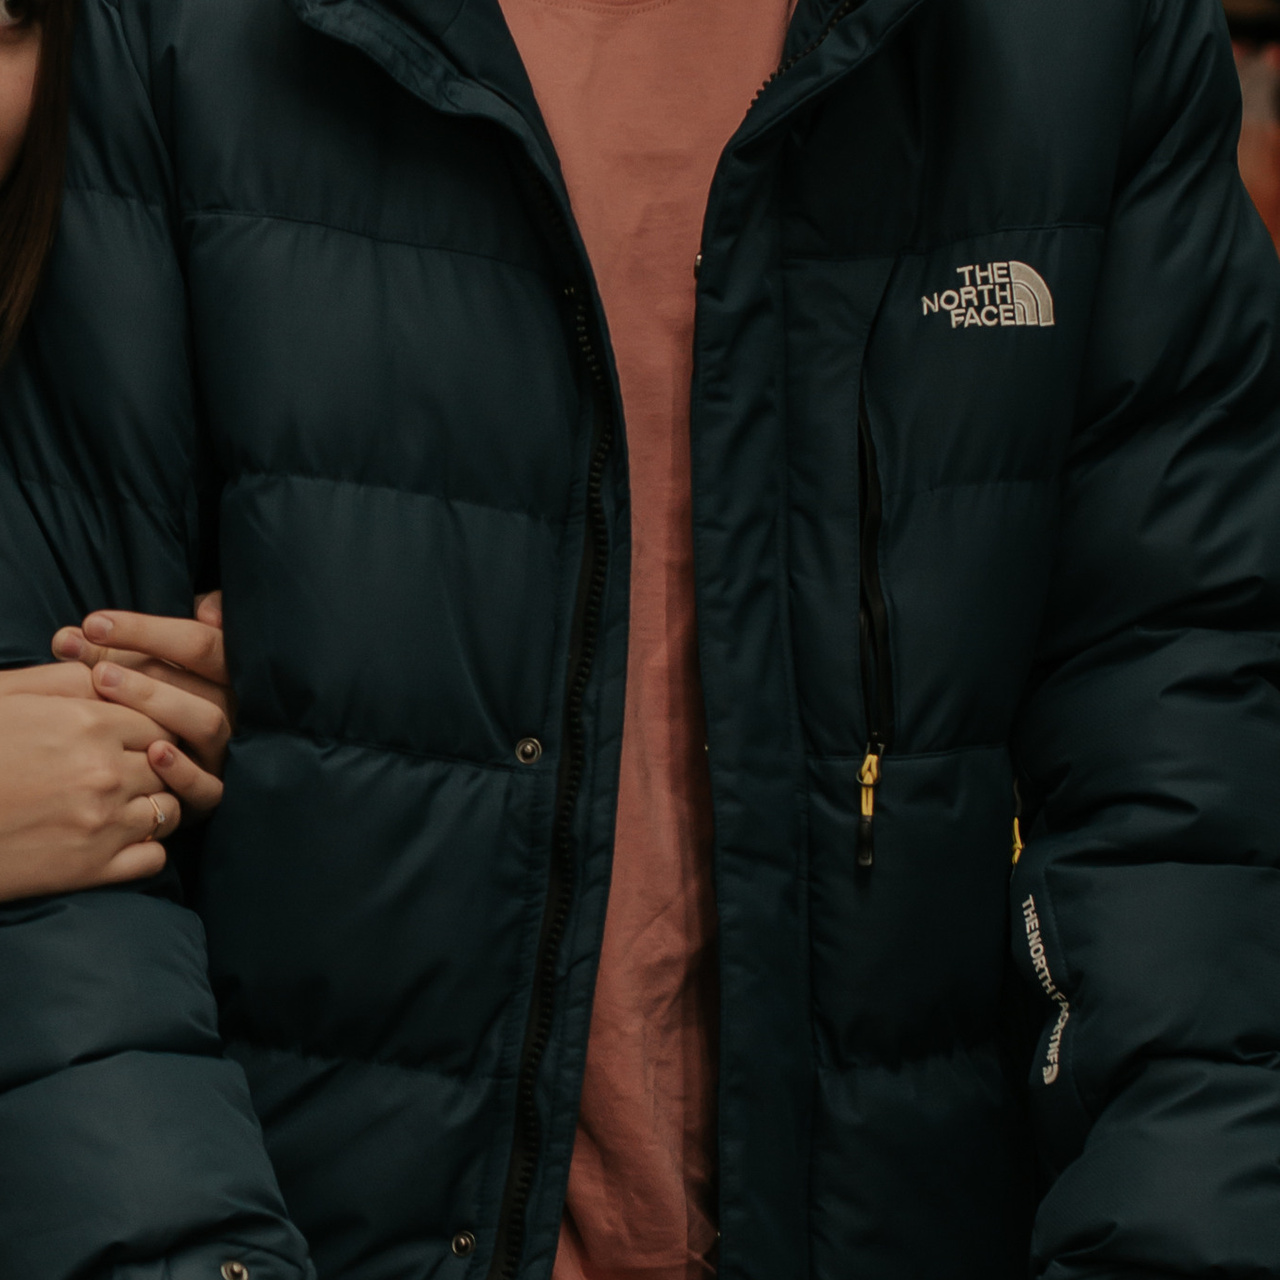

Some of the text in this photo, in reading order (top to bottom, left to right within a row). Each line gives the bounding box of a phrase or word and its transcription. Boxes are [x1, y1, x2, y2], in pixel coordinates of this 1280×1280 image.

[956, 262, 1010, 286] THE
[921, 284, 1012, 316] NORTH
[950, 304, 1016, 328] FACE
[1022, 894, 1040, 933] THE
[1027, 929, 1057, 996] NORTH
